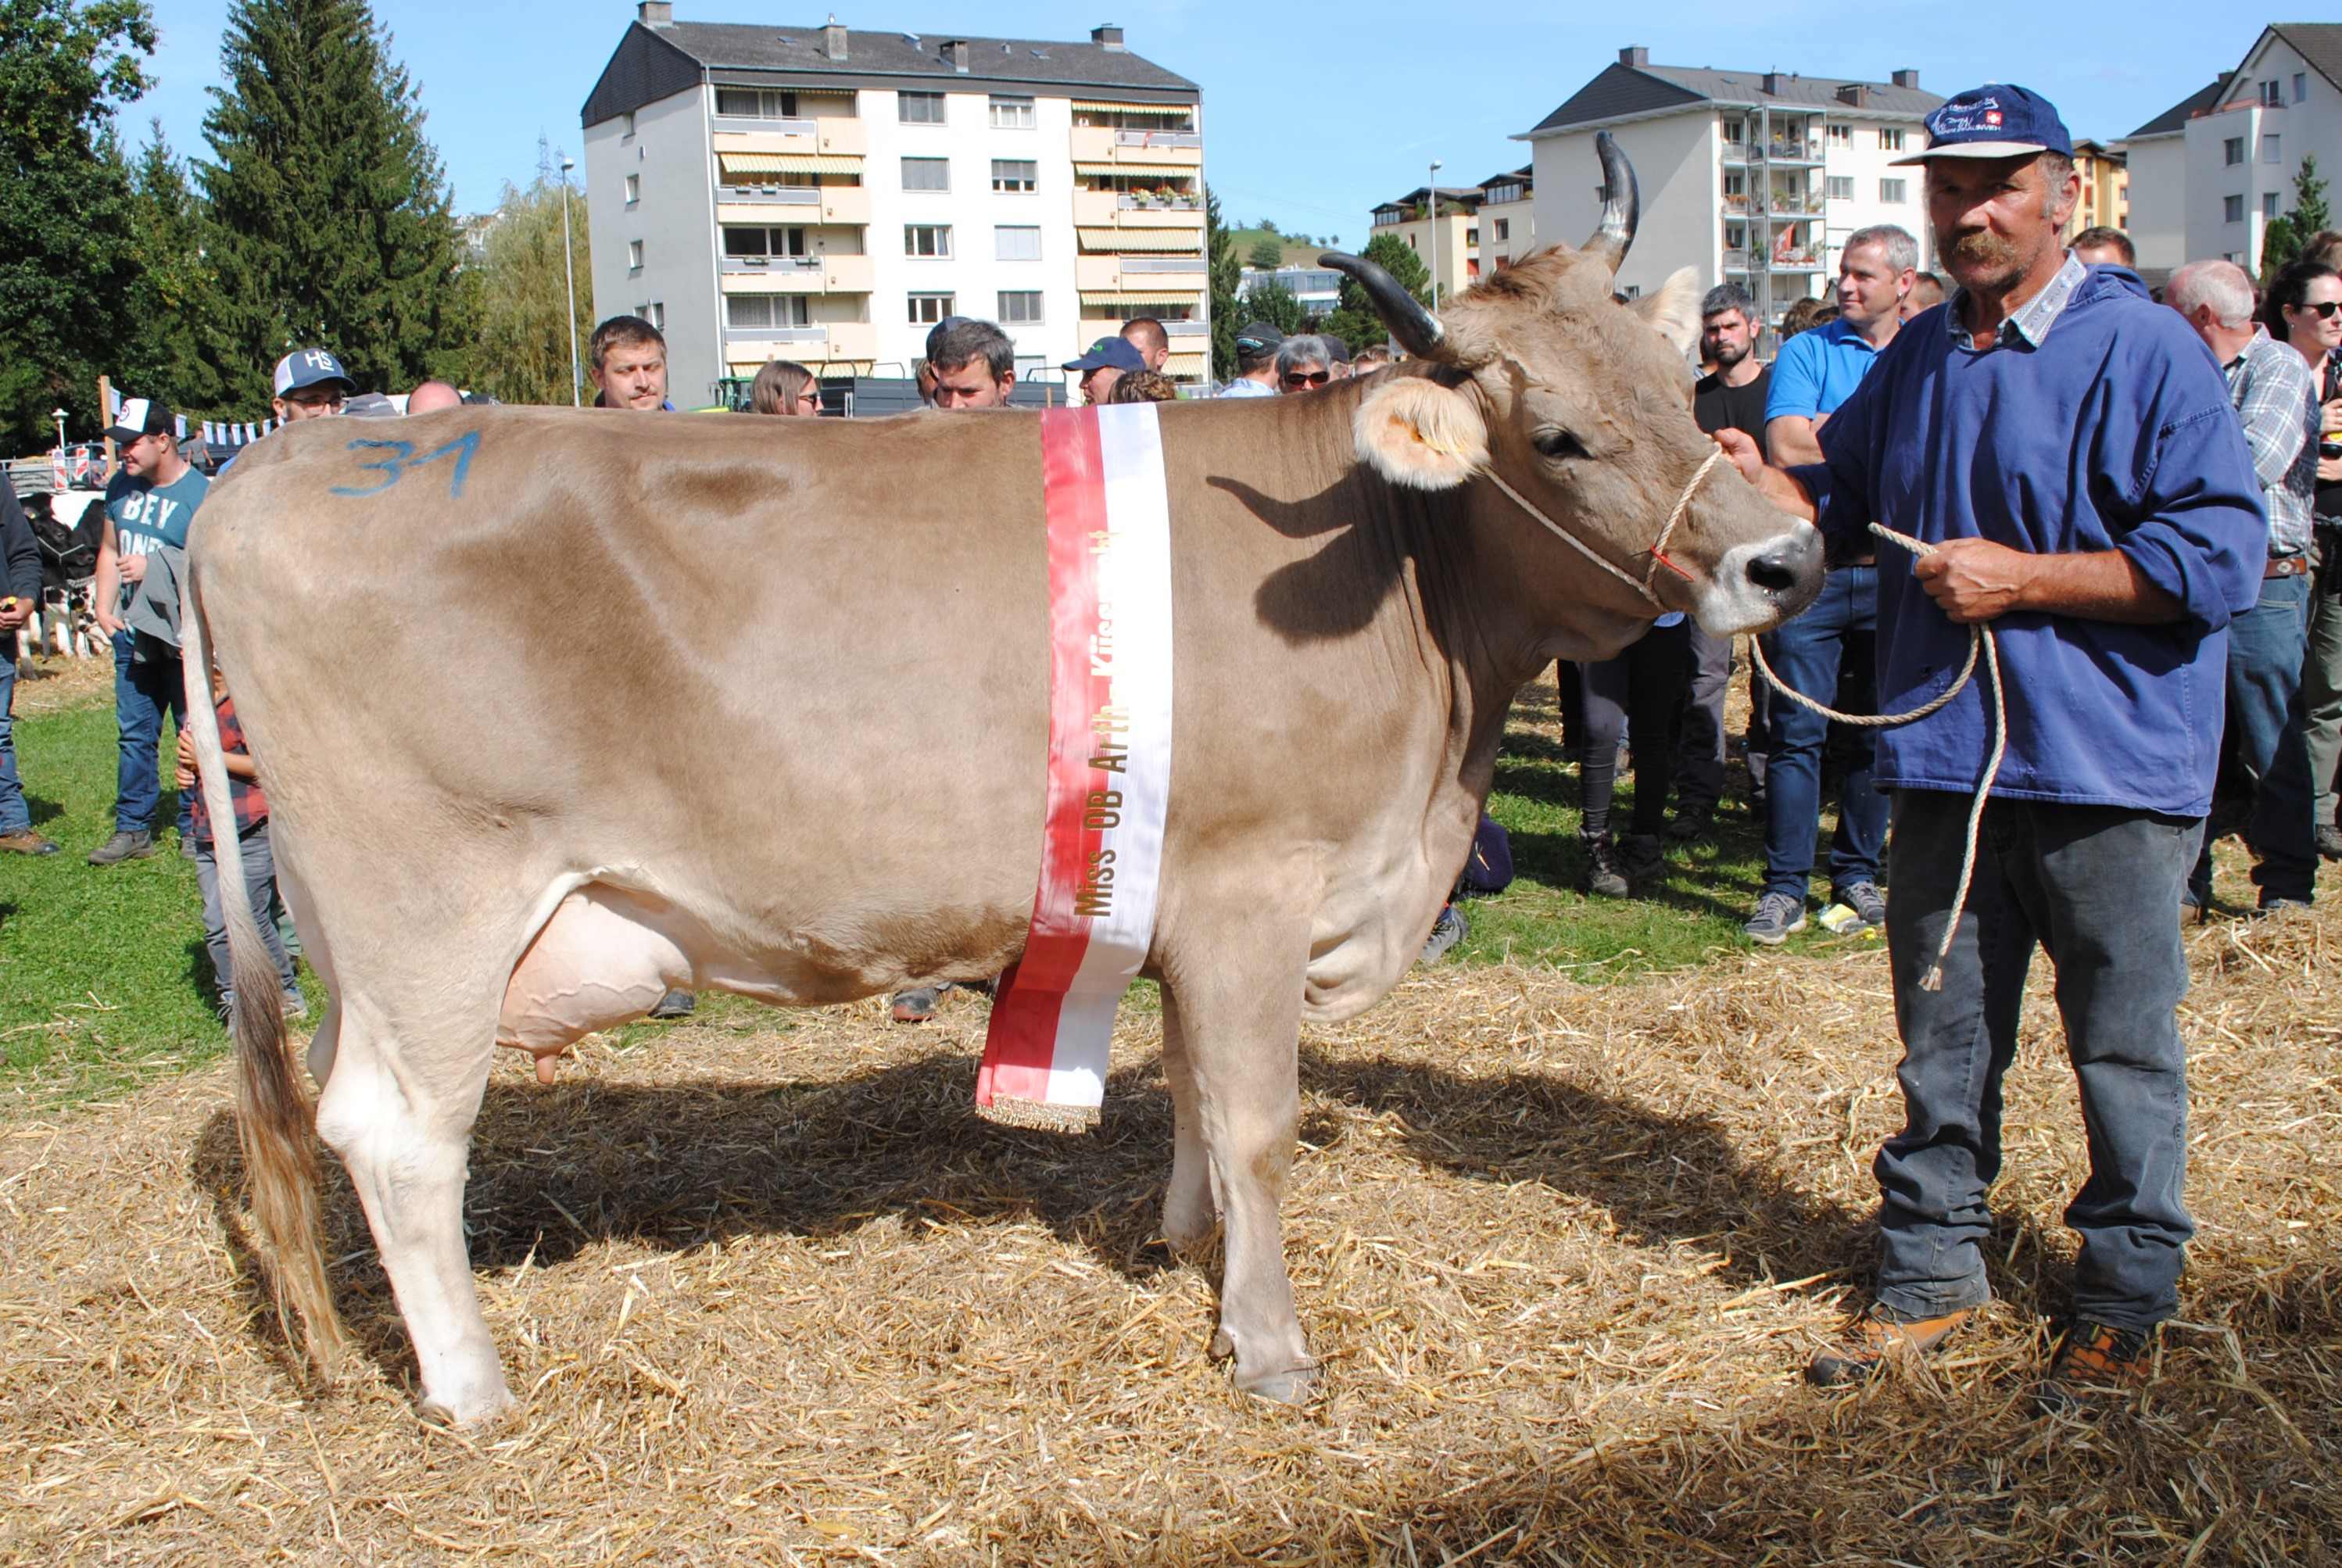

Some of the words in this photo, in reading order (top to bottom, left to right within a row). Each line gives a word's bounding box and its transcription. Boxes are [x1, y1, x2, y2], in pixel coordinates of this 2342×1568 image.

[305, 351, 335, 372] HLS
[328, 428, 481, 499] 31
[122, 489, 179, 529] BEY
[1083, 789, 1123, 830] OB
[1073, 849, 1117, 917] Miss
